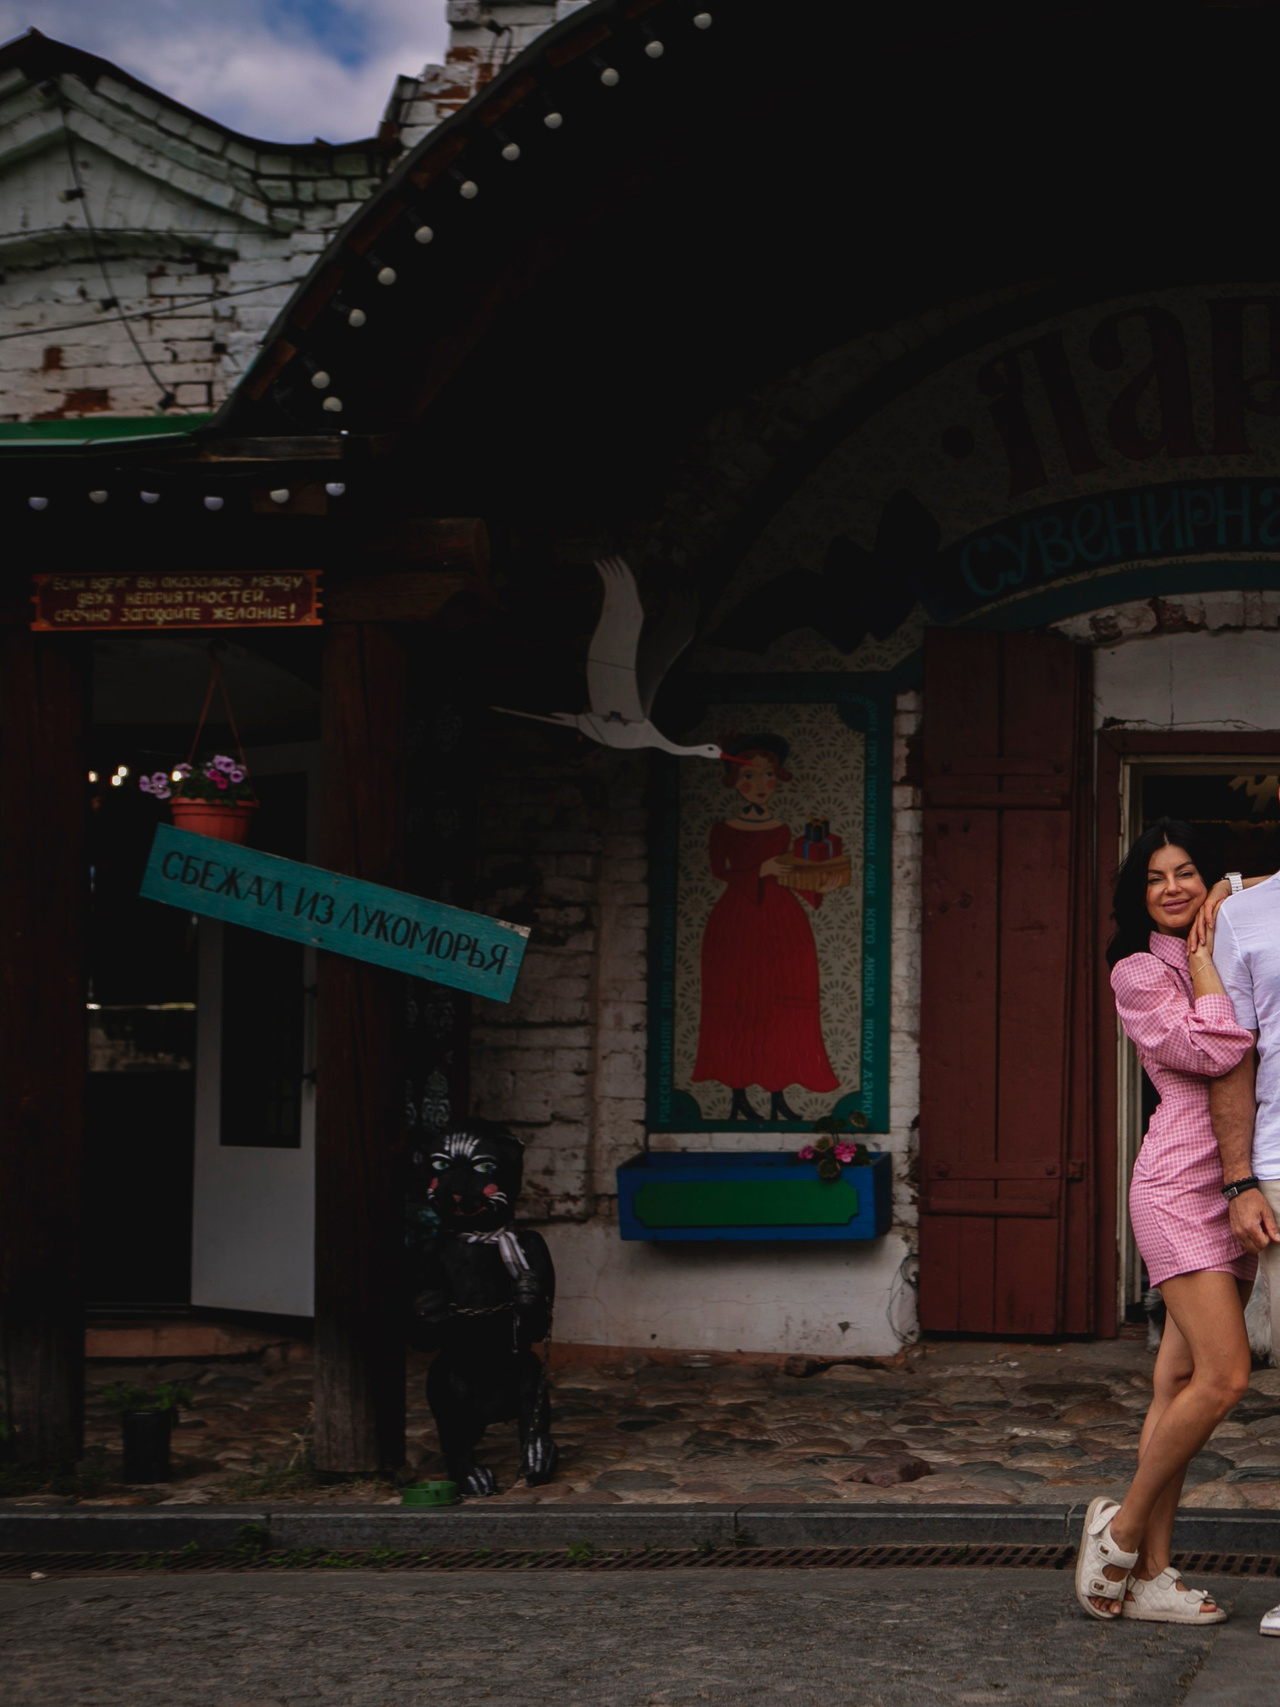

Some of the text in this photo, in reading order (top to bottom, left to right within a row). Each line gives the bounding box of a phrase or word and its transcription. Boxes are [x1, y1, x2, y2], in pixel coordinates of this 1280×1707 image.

[161, 851, 510, 975] СБЕЖАЛ ИЗ ЛУКОМОРЬЯ
